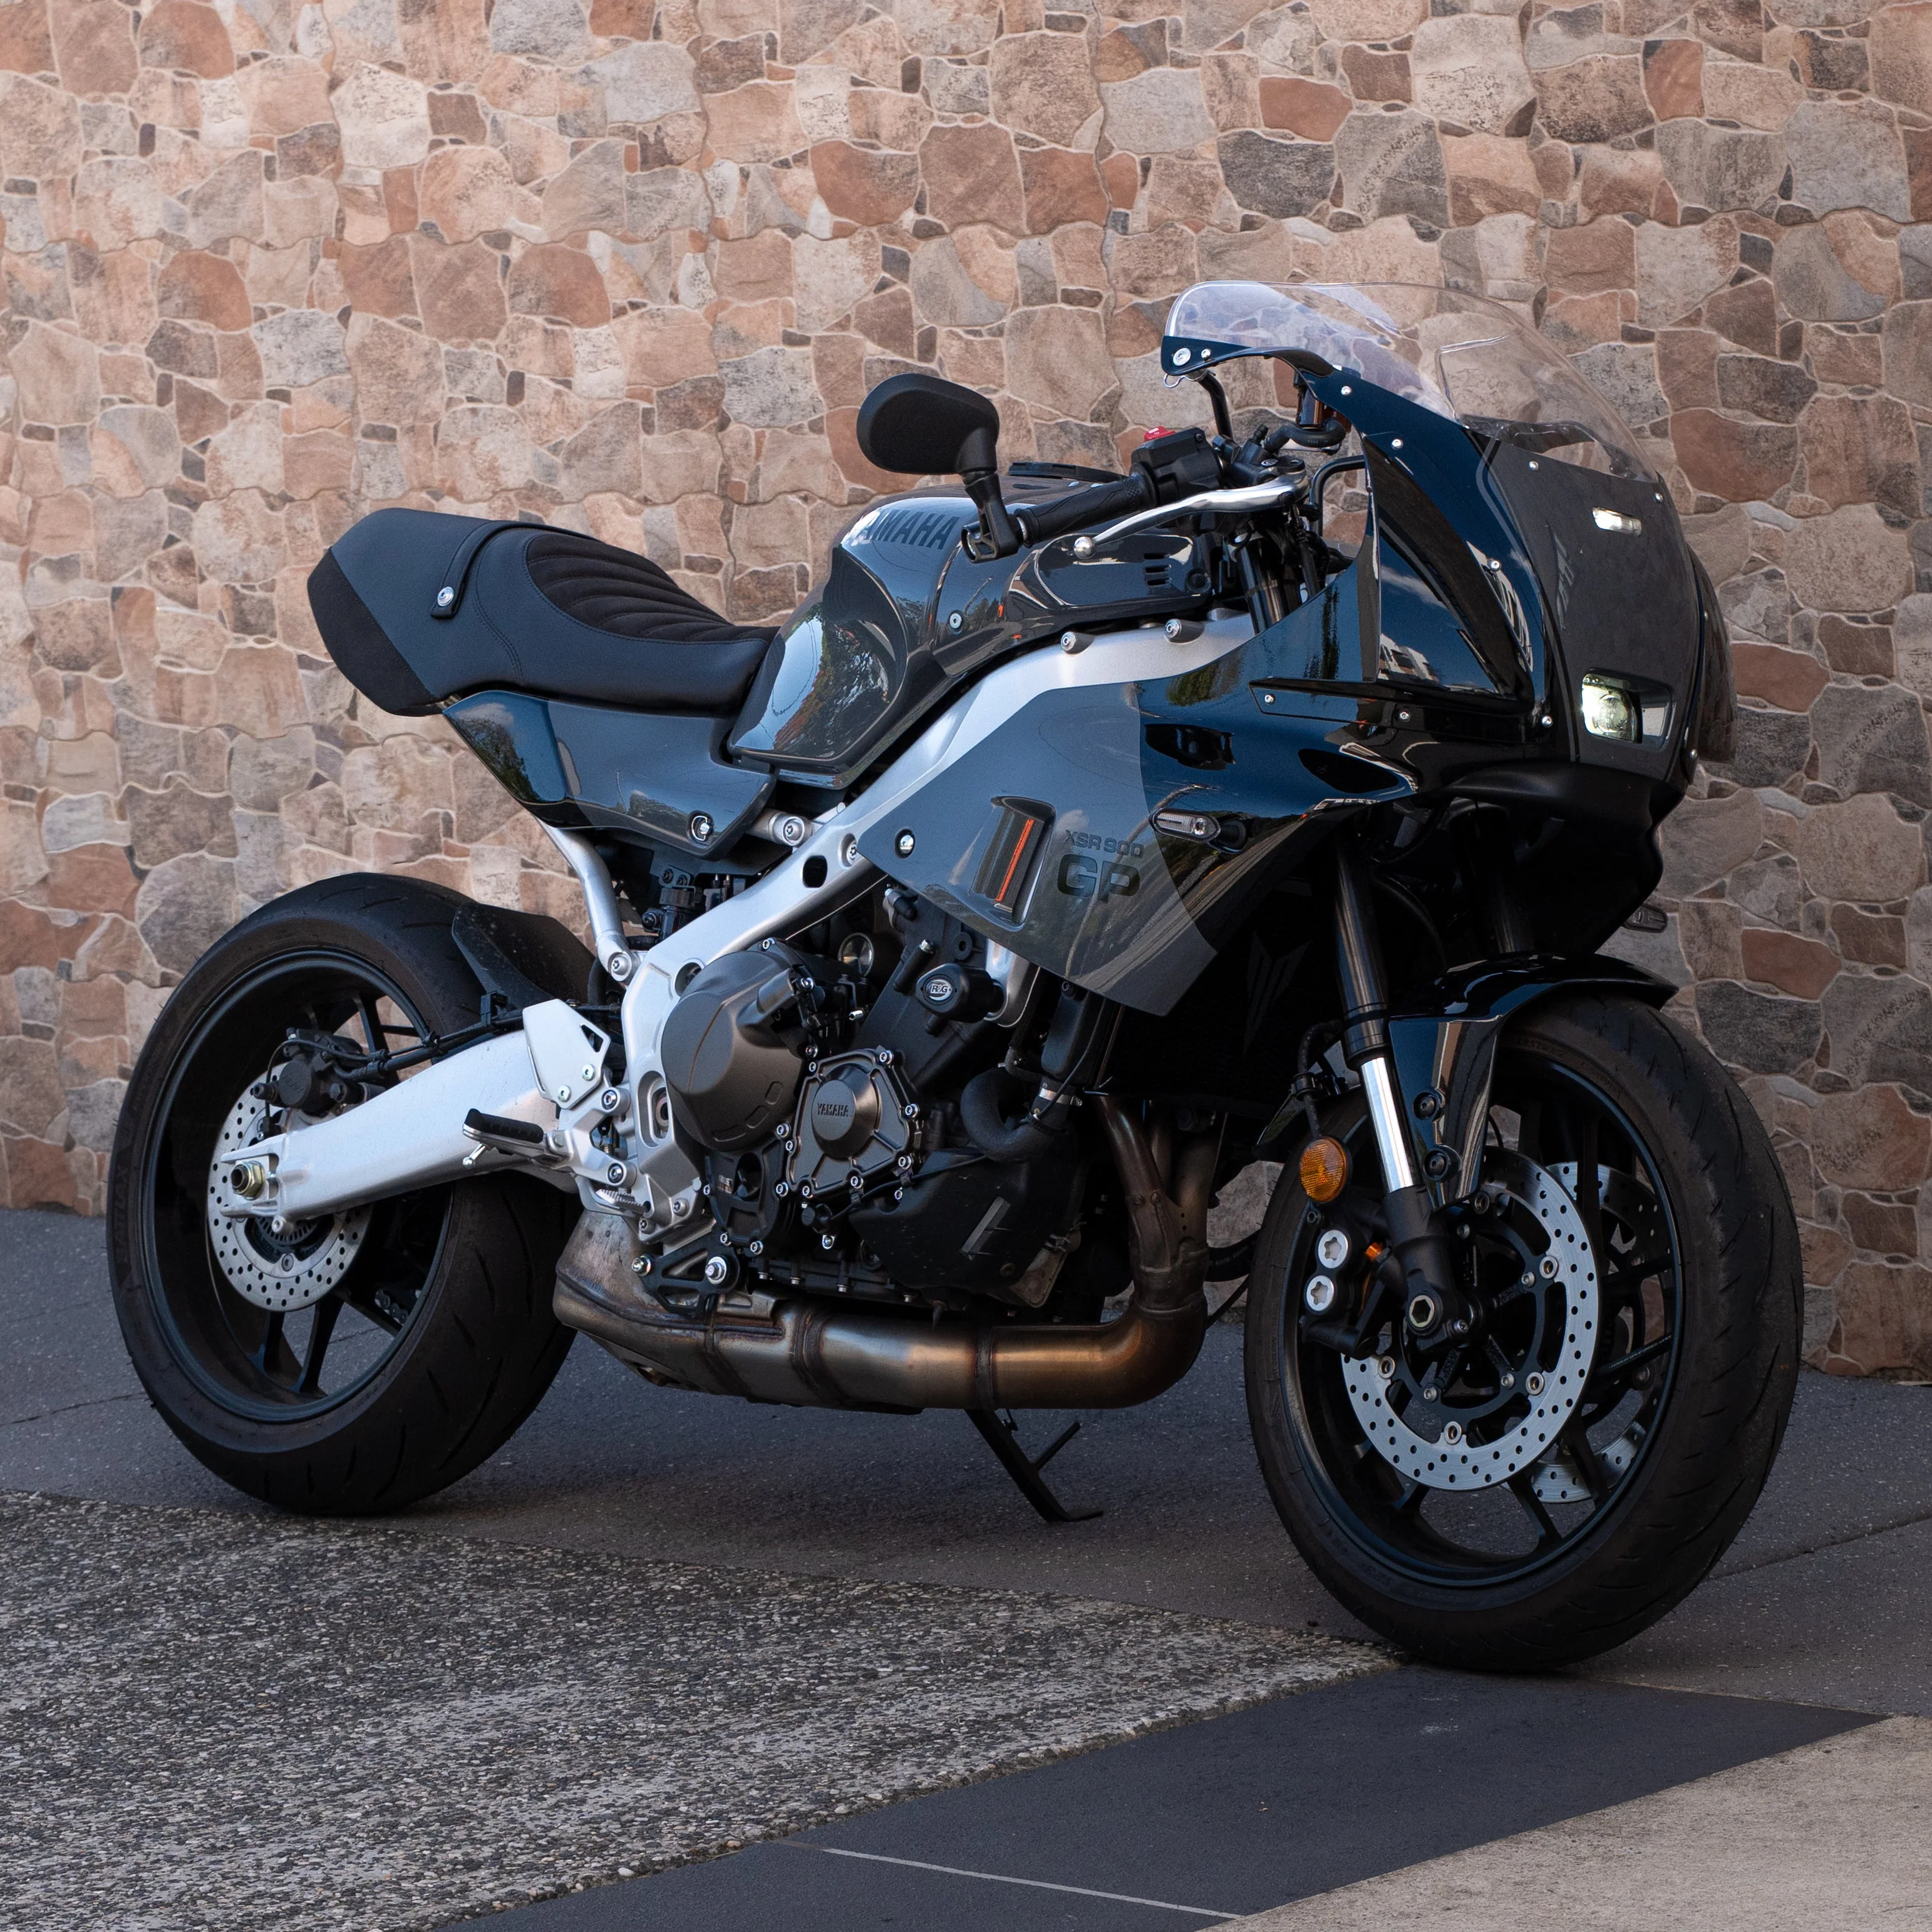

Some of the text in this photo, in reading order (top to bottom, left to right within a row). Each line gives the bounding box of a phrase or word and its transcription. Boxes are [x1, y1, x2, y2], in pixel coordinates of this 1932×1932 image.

[854, 509, 960, 550] AMAHA
[1056, 854, 1140, 903] GP
[931, 985, 948, 994] R&G
[817, 1103, 849, 1117] YAMAHA
